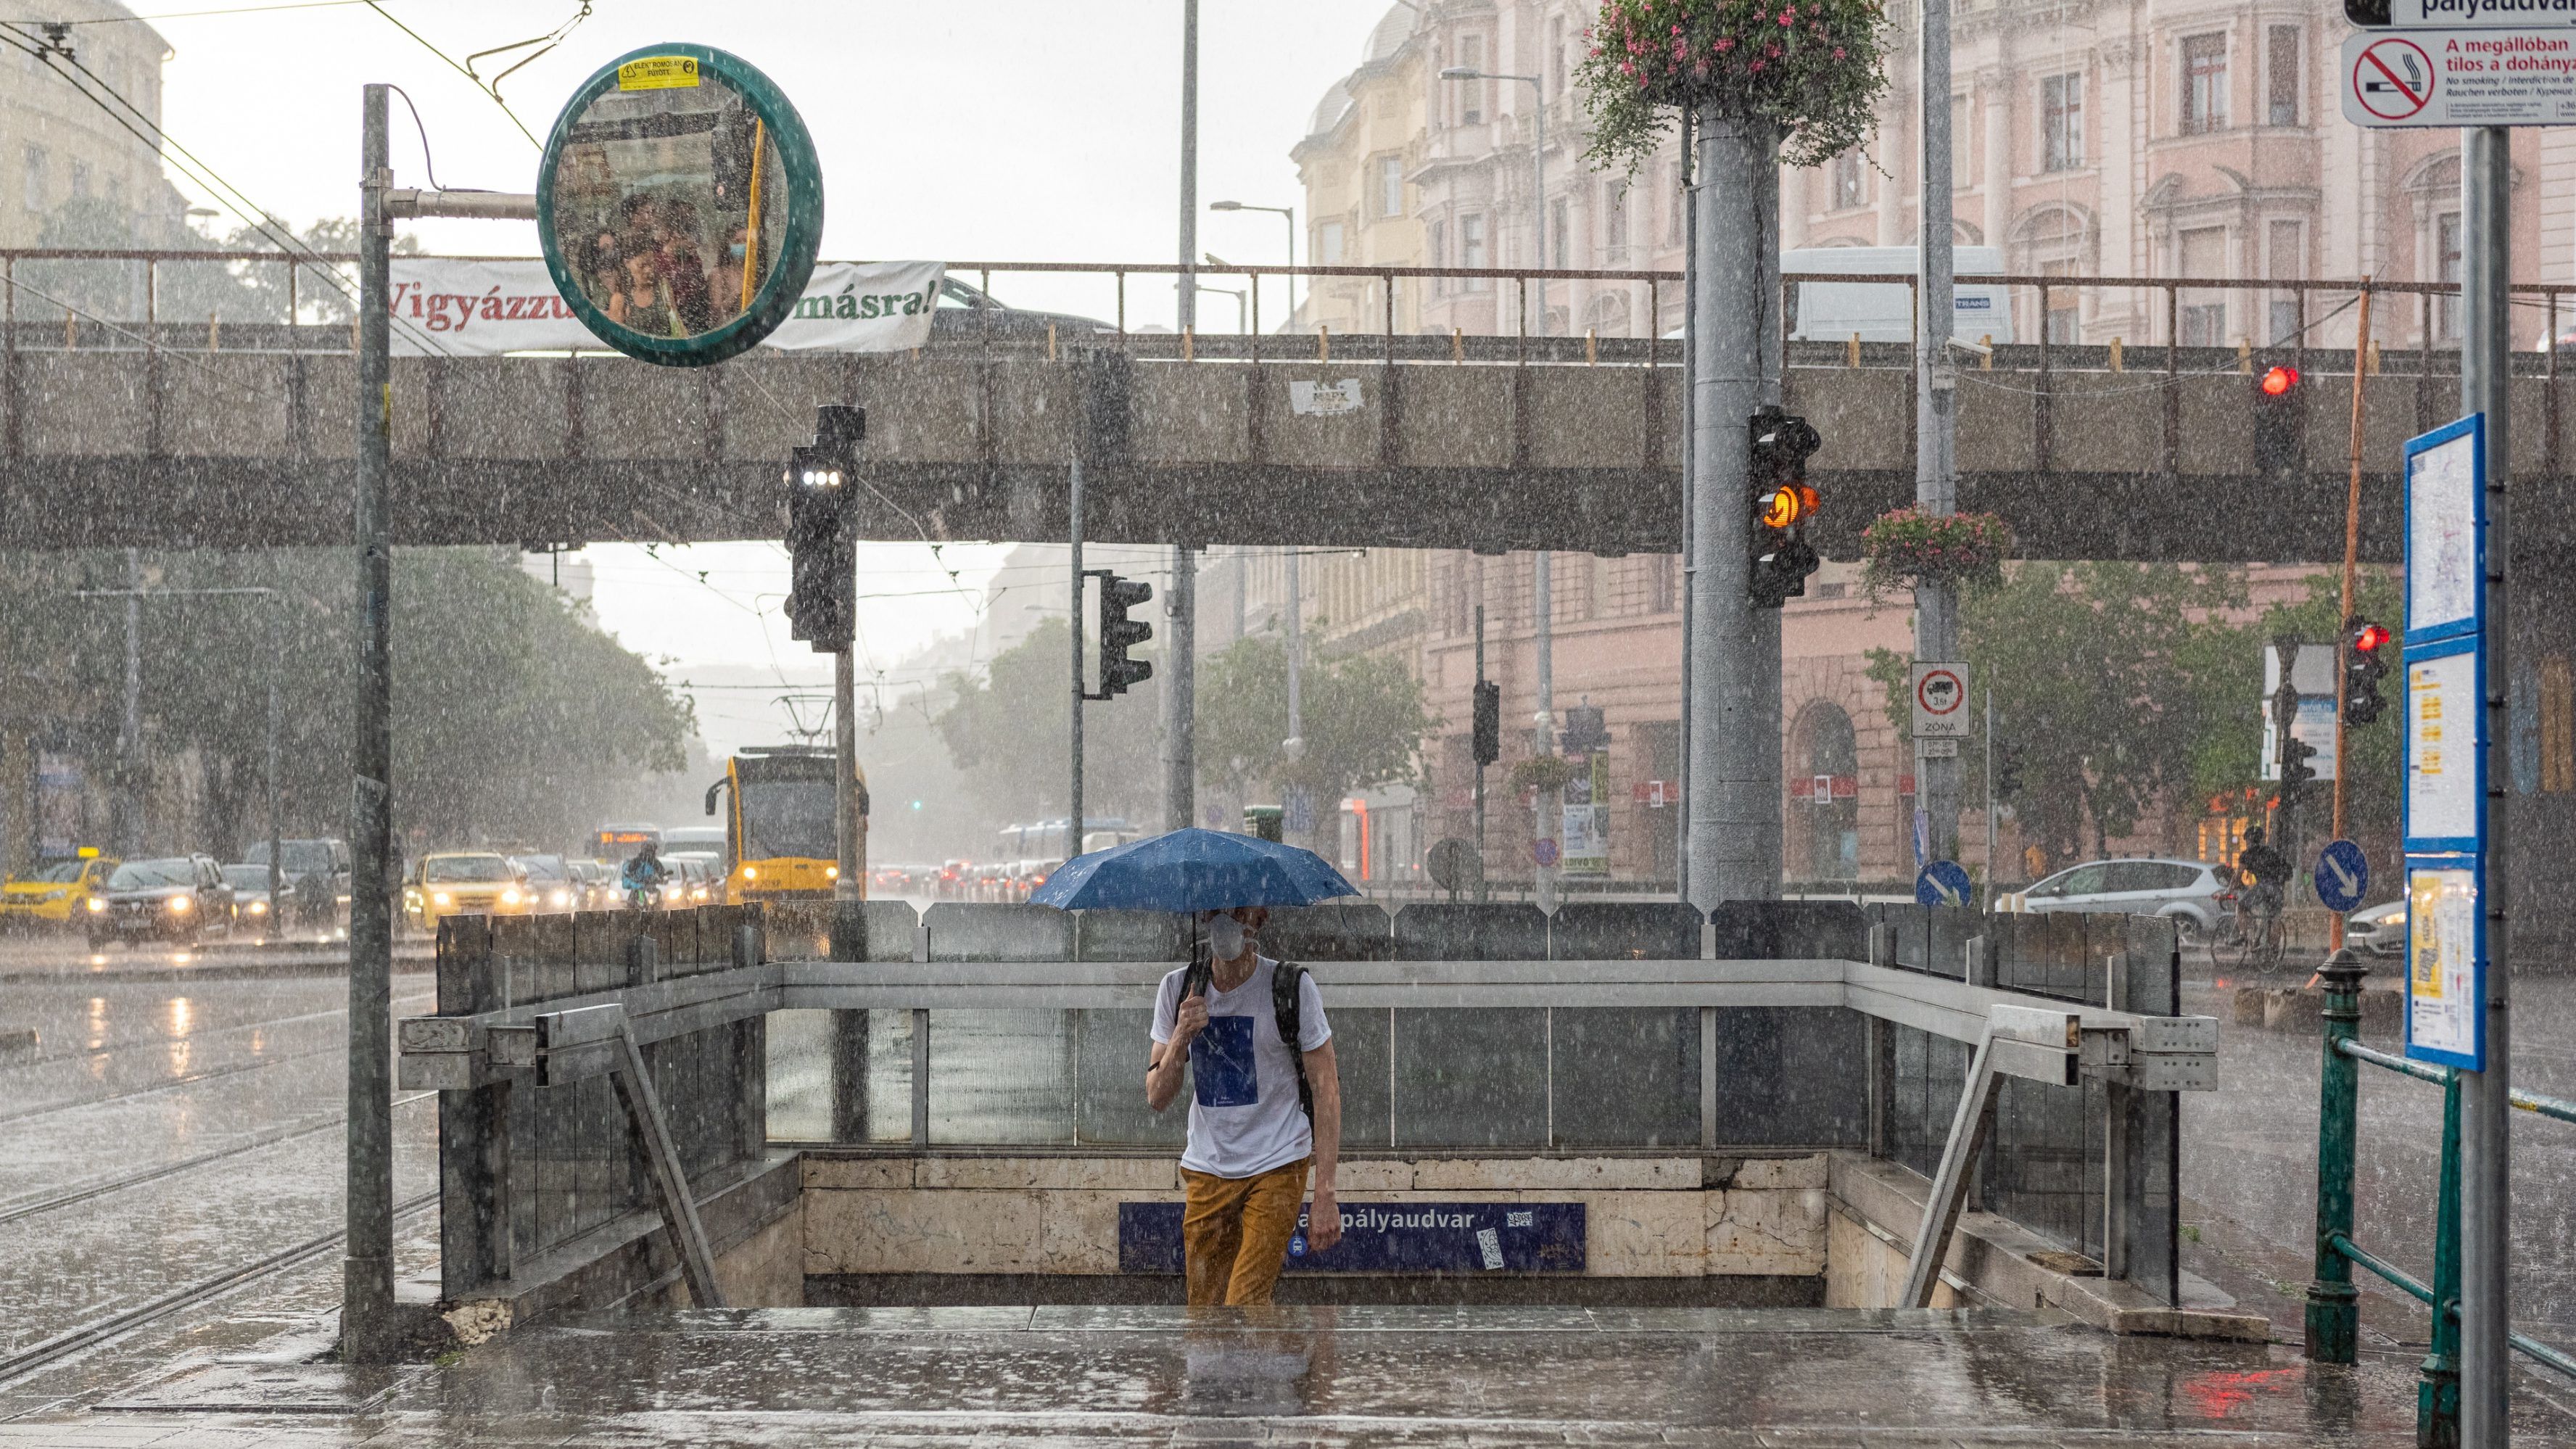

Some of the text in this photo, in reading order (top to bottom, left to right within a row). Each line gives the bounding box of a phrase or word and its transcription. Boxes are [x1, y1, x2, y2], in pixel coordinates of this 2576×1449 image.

[2445, 36, 2569, 56] A megállóban
[2446, 57, 2484, 71] tilos
[2490, 60, 2500, 70] a
[2462, 76, 2500, 87] smoking
[2509, 75, 2560, 85] Interdiction
[2563, 75, 2574, 84] de
[2488, 88, 2527, 96] verboten
[1340, 1209, 1475, 1233] pályaudvar
